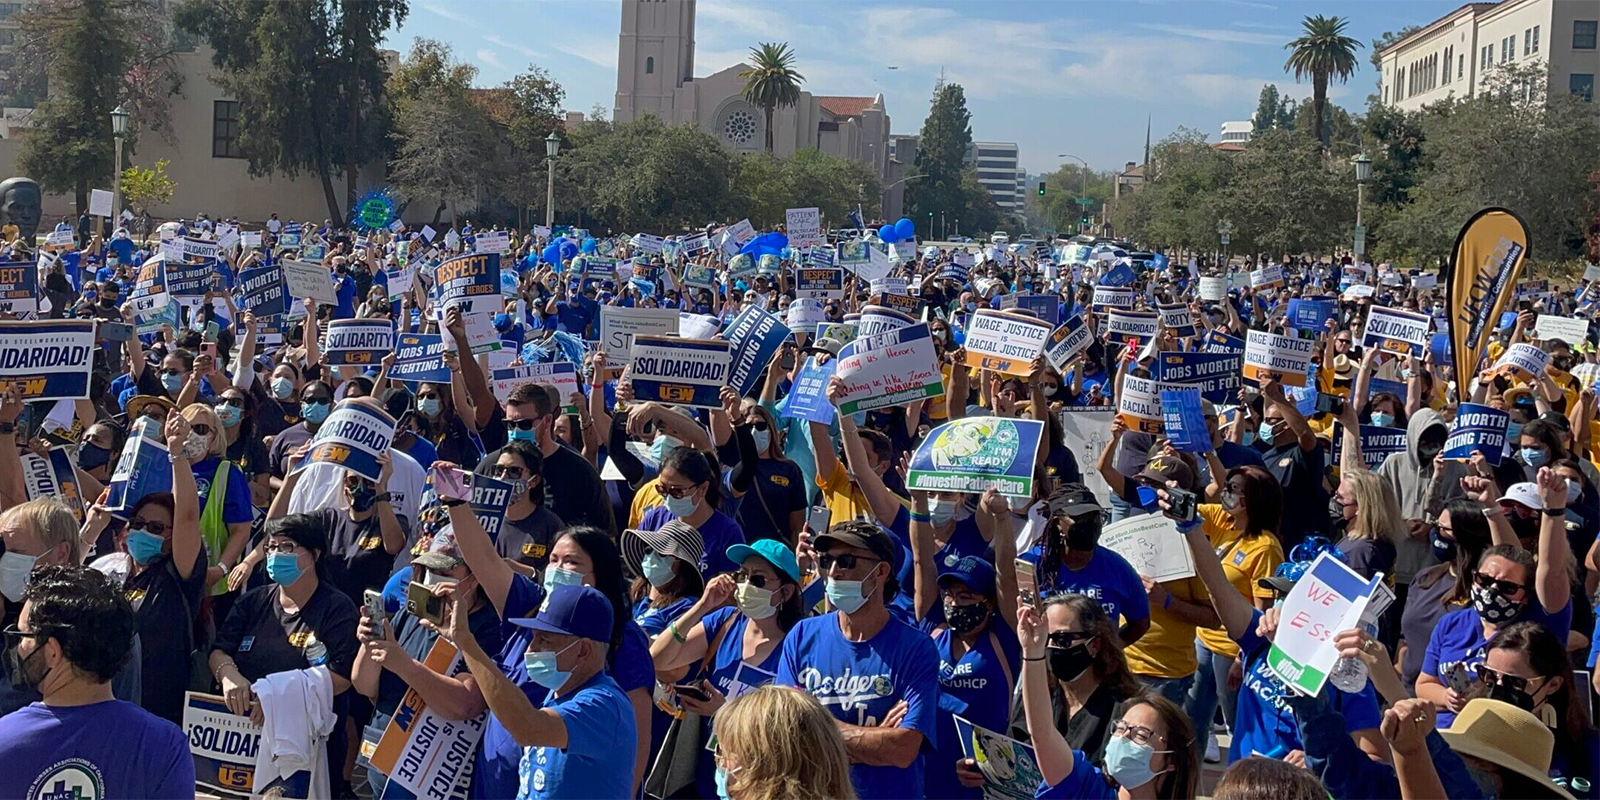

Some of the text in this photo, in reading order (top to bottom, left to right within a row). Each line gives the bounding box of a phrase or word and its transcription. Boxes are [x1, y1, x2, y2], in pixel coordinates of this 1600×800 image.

[788, 212, 816, 220] PATIENT
[184, 243, 216, 256] SOLIDARITY
[168, 264, 213, 280] OBS WORTH
[437, 256, 488, 286] RESPECT
[803, 271, 836, 280] RESPECT
[168, 280, 202, 292] IGHTING
[246, 269, 280, 292] WORTH
[1480, 294, 1496, 318] Better
[1492, 246, 1521, 293] Communities
[264, 286, 282, 302] FOR
[449, 284, 493, 298] CARE HEROES
[138, 298, 154, 310] USW
[886, 294, 920, 308] RESPECT
[1094, 294, 1132, 305] SOLIDARITY
[1166, 312, 1190, 326] ARITY
[730, 308, 761, 350] WORTH
[975, 318, 1045, 340] WAGE JUSTICE
[1368, 319, 1427, 342] SOLIDARITY
[328, 332, 392, 348] SOLIDARITY
[854, 331, 900, 354] I'M READY
[1249, 332, 1310, 352] WAGE JUSTICE
[0, 346, 90, 368] IDARIDAD!
[345, 351, 372, 362] USW
[396, 346, 424, 360] JOBS
[730, 317, 776, 392] IGHTING FOR
[886, 347, 916, 358] Heroes
[968, 338, 1037, 360] RACIAL JUSTICE
[1208, 344, 1230, 354] JOBS
[1514, 344, 1548, 362] JUSTICE
[390, 360, 439, 374] FIGHTING
[632, 357, 726, 380] ¡SOLIDARIDAD!
[982, 357, 1012, 372] USW
[1164, 358, 1239, 380] JOBS WORTH
[1247, 352, 1306, 372] RACIAL JUSTICE
[1510, 356, 1540, 375] JUSTICE
[530, 364, 554, 377] READY
[1256, 370, 1284, 382] UW
[811, 379, 822, 388] JOBS
[884, 374, 901, 384] like
[1126, 377, 1150, 394] WAGE
[660, 385, 695, 401] USW
[806, 388, 820, 396] CARE
[1122, 399, 1152, 416] RACIAL
[1168, 413, 1180, 422] JOBS
[1460, 414, 1508, 428] WORTH
[1169, 422, 1183, 430] CARE
[1478, 432, 1504, 446] FOR
[312, 445, 352, 462] USW
[994, 448, 1012, 457] I'M
[971, 456, 1009, 466] READY
[470, 487, 508, 506] RTH
[476, 516, 499, 534] OR
[1115, 522, 1168, 539] #BestJobsBestCare
[522, 543, 546, 558] USW
[1307, 581, 1340, 606] WE
[1290, 611, 1332, 642] ESS
[204, 716, 262, 730] UNITED STEEL
[442, 722, 455, 736] IS
[188, 724, 262, 758] ¡SOLIDAR
[398, 715, 440, 782] JUSTICE
[427, 730, 473, 800] JUSTICE
[32, 766, 53, 786] NURSES
[54, 758, 91, 768] ASSOCIATIONS
[96, 769, 105, 800] CALIFORNIA
[218, 766, 254, 789] US
